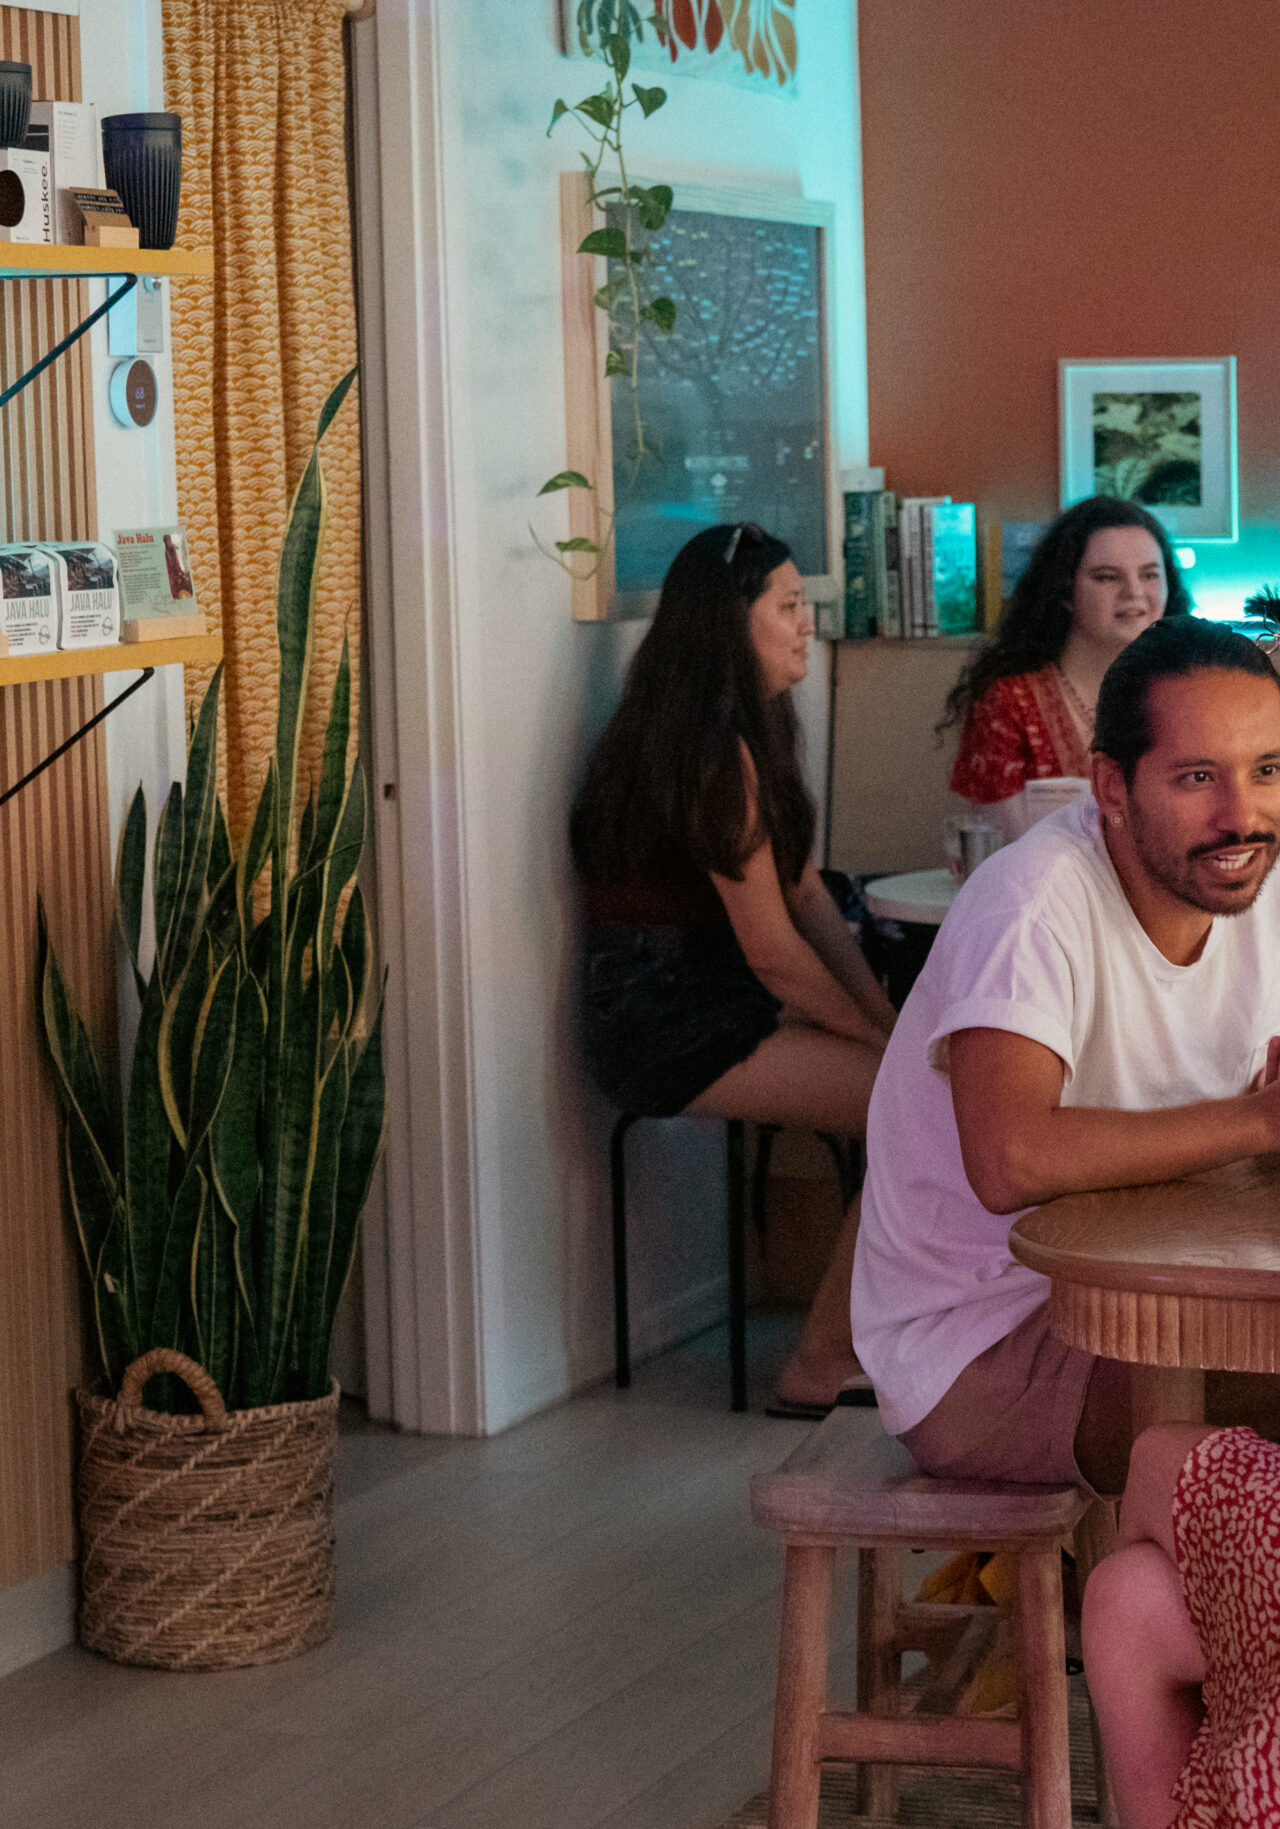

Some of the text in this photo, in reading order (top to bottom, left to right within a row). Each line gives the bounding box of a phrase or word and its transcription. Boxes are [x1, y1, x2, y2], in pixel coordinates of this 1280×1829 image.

[117, 531, 154, 545] Java Halu
[5, 599, 50, 621] JAVA HALU
[70, 591, 112, 612] JAVA HALU
